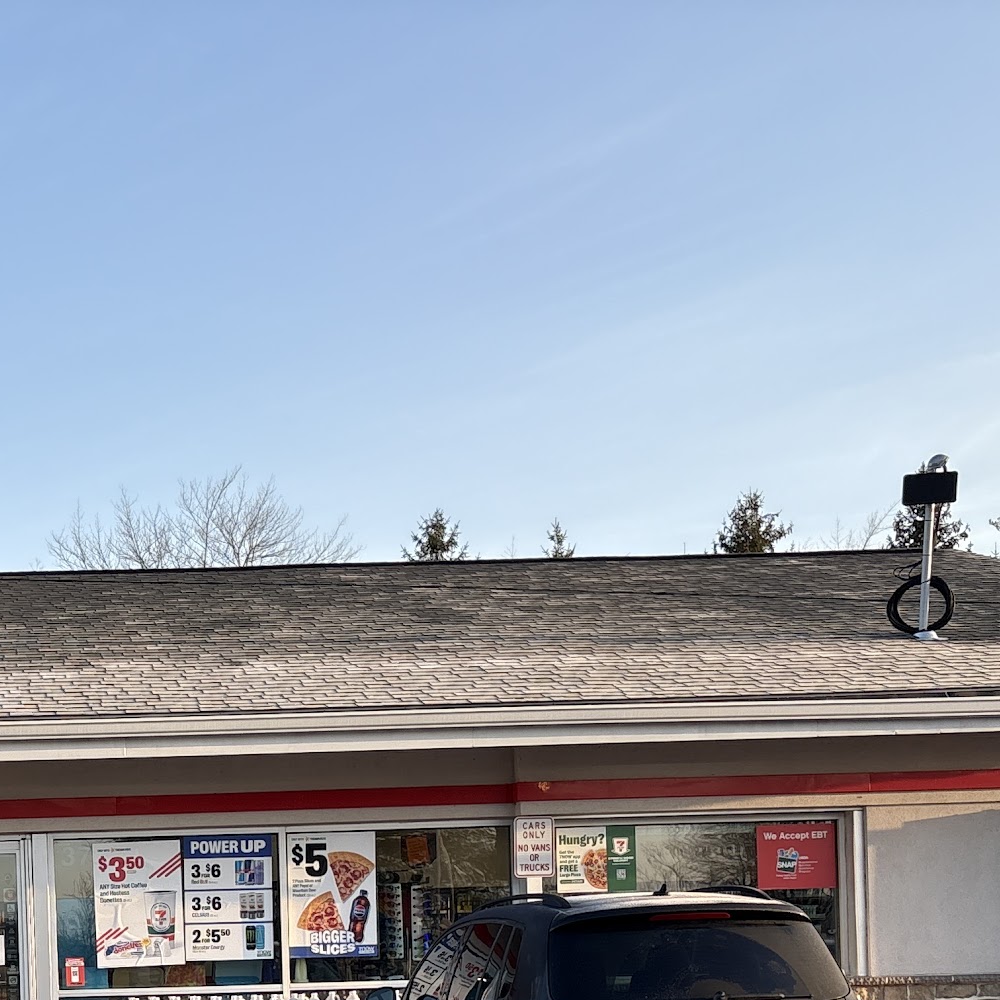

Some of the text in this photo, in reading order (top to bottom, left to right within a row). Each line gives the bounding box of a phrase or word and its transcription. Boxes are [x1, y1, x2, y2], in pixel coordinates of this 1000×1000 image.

[522, 822, 546, 830] CARS
[522, 831, 546, 839] ONLY
[558, 833, 605, 847] Hungry?
[763, 831, 828, 841] We Accept EBT
[190, 839, 266, 854] POWER UP
[518, 844, 551, 852] NO VANS
[292, 843, 328, 877] $5
[777, 861, 797, 869] SNAP
[191, 864, 200, 878] 3
[519, 864, 550, 872] TRUCKS
[191, 897, 201, 910] 3
[192, 929, 201, 943] 2
[311, 930, 355, 943] BIGGER
[311, 943, 356, 955] SLICES
